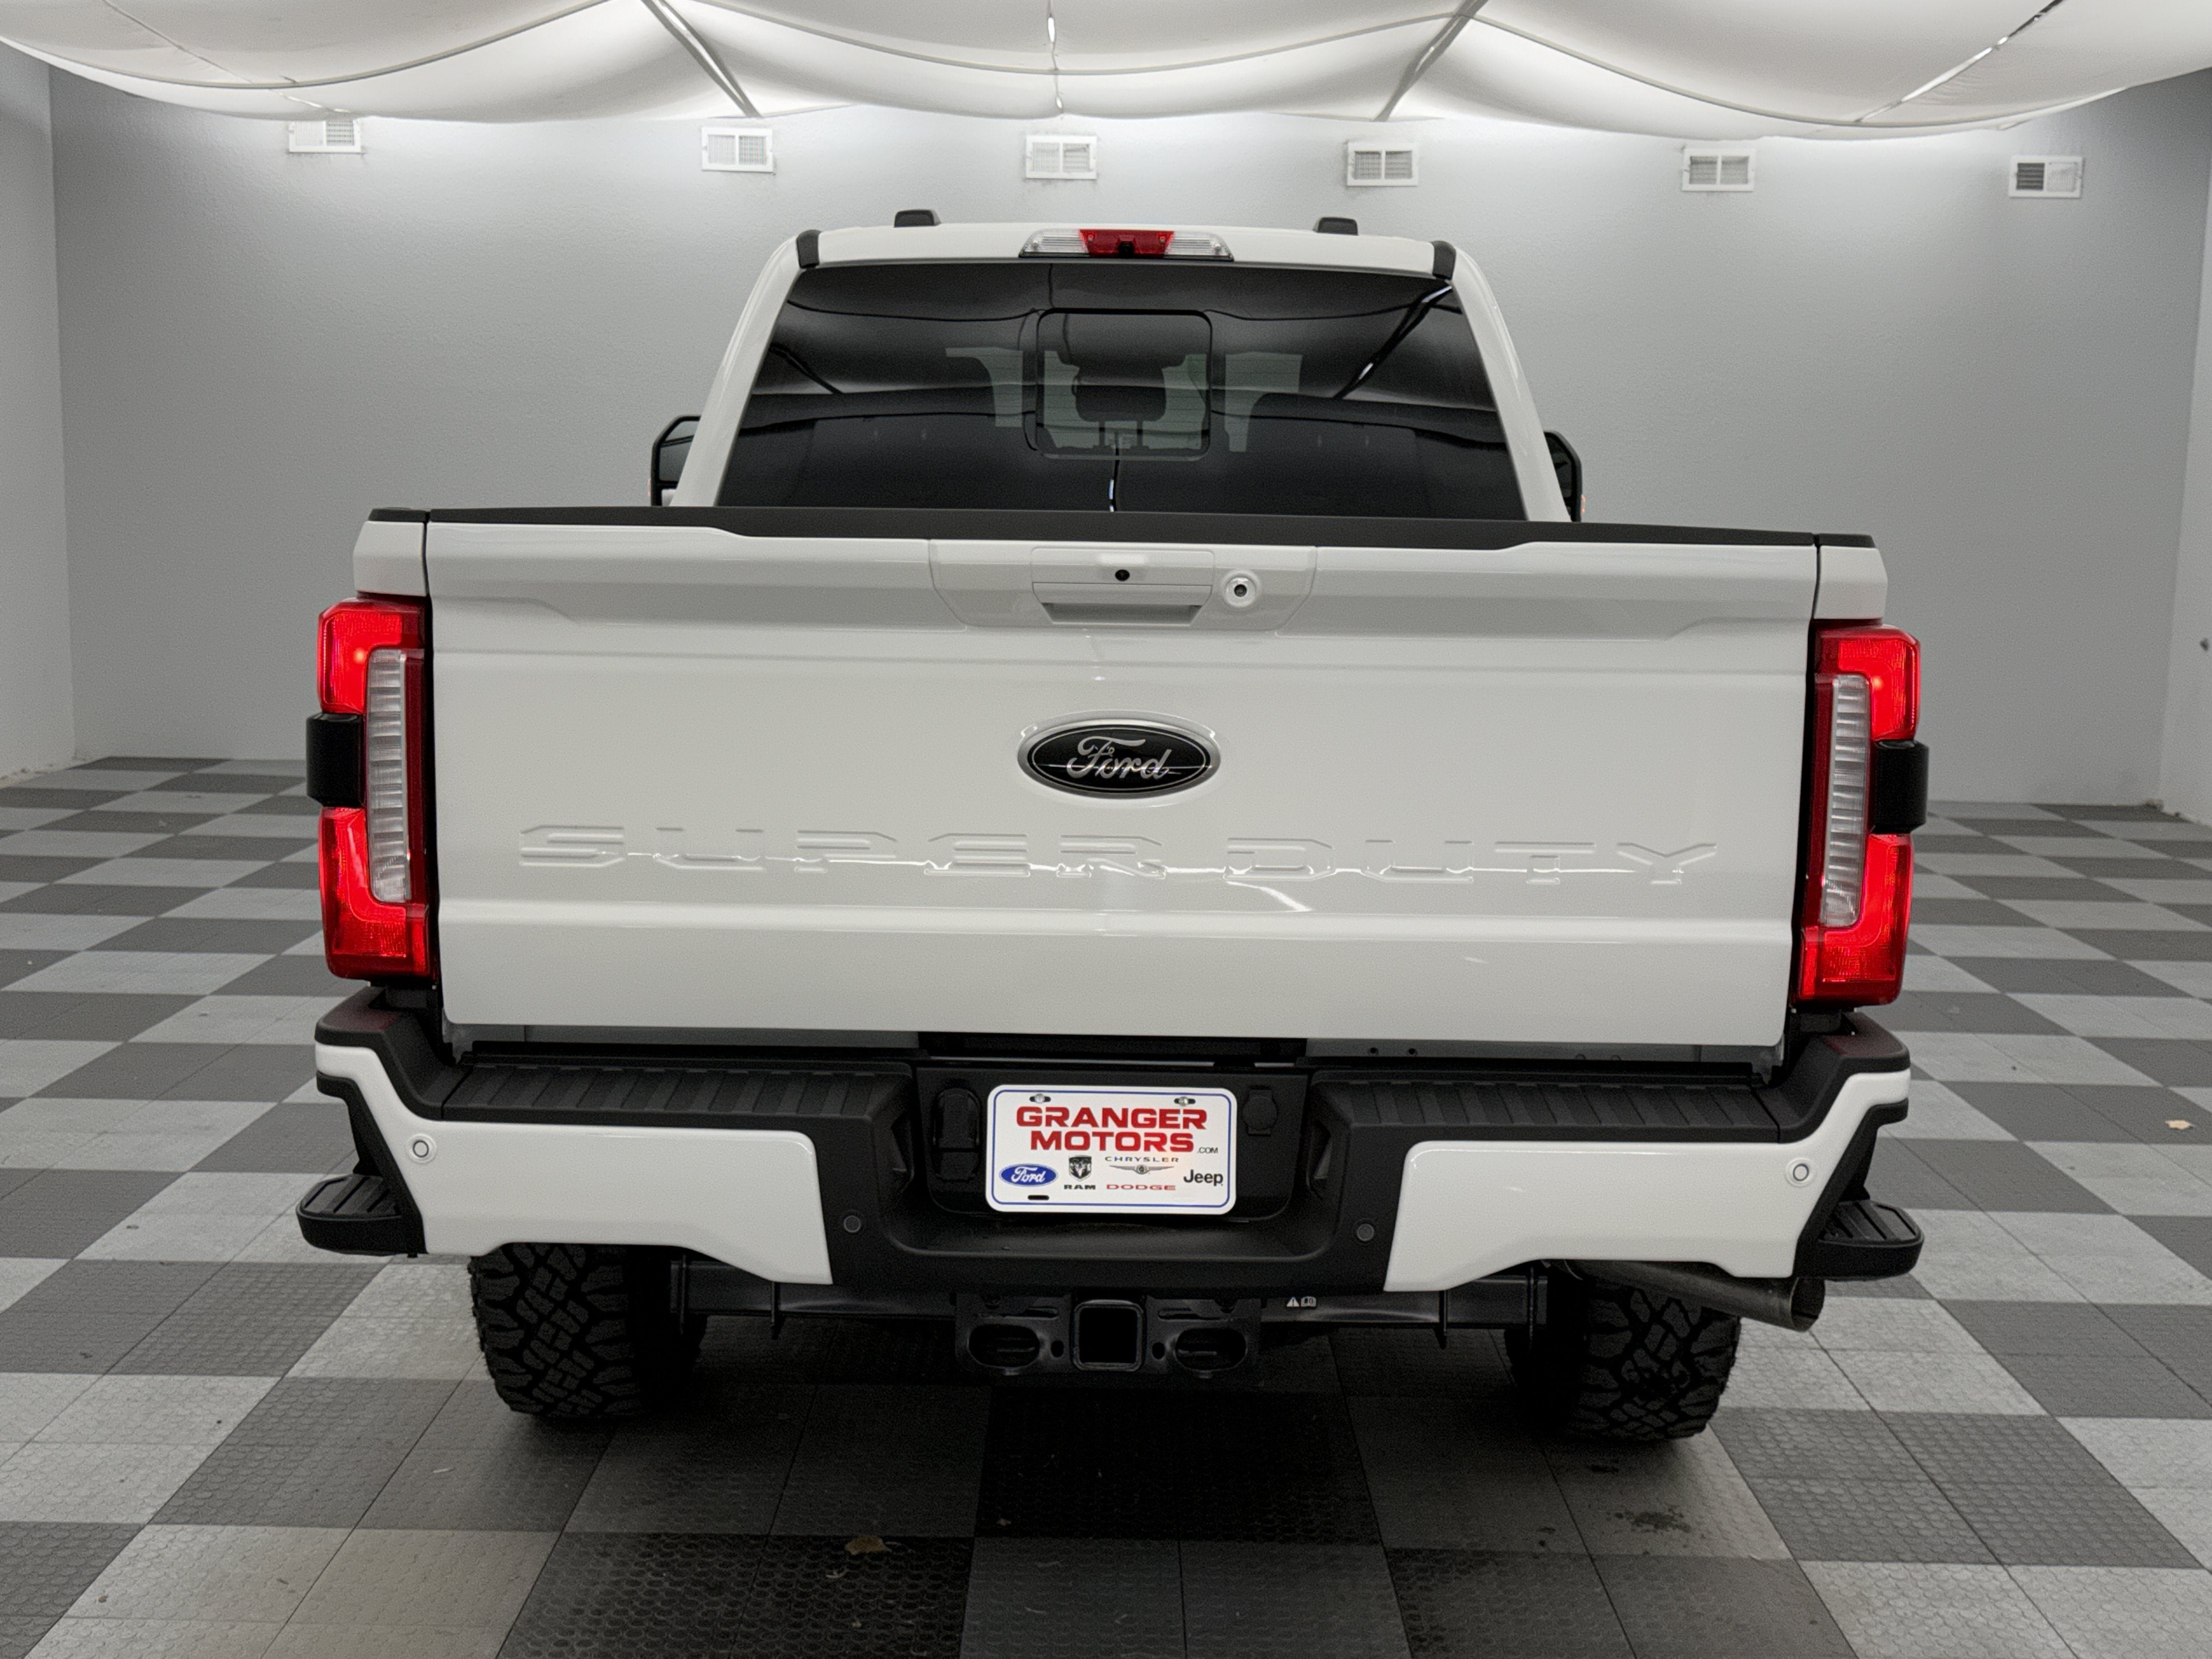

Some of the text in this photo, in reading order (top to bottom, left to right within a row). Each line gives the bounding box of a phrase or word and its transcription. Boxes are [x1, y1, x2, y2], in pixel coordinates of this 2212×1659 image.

[1066, 735, 1172, 780] Ford
[520, 825, 1717, 885] SUPER DUTY
[1016, 1106, 1207, 1130] GRANGER
[1030, 1130, 1194, 1153] MOTORS
[1011, 1166, 1045, 1183] Ford
[1183, 1169, 1223, 1186] Jeep
